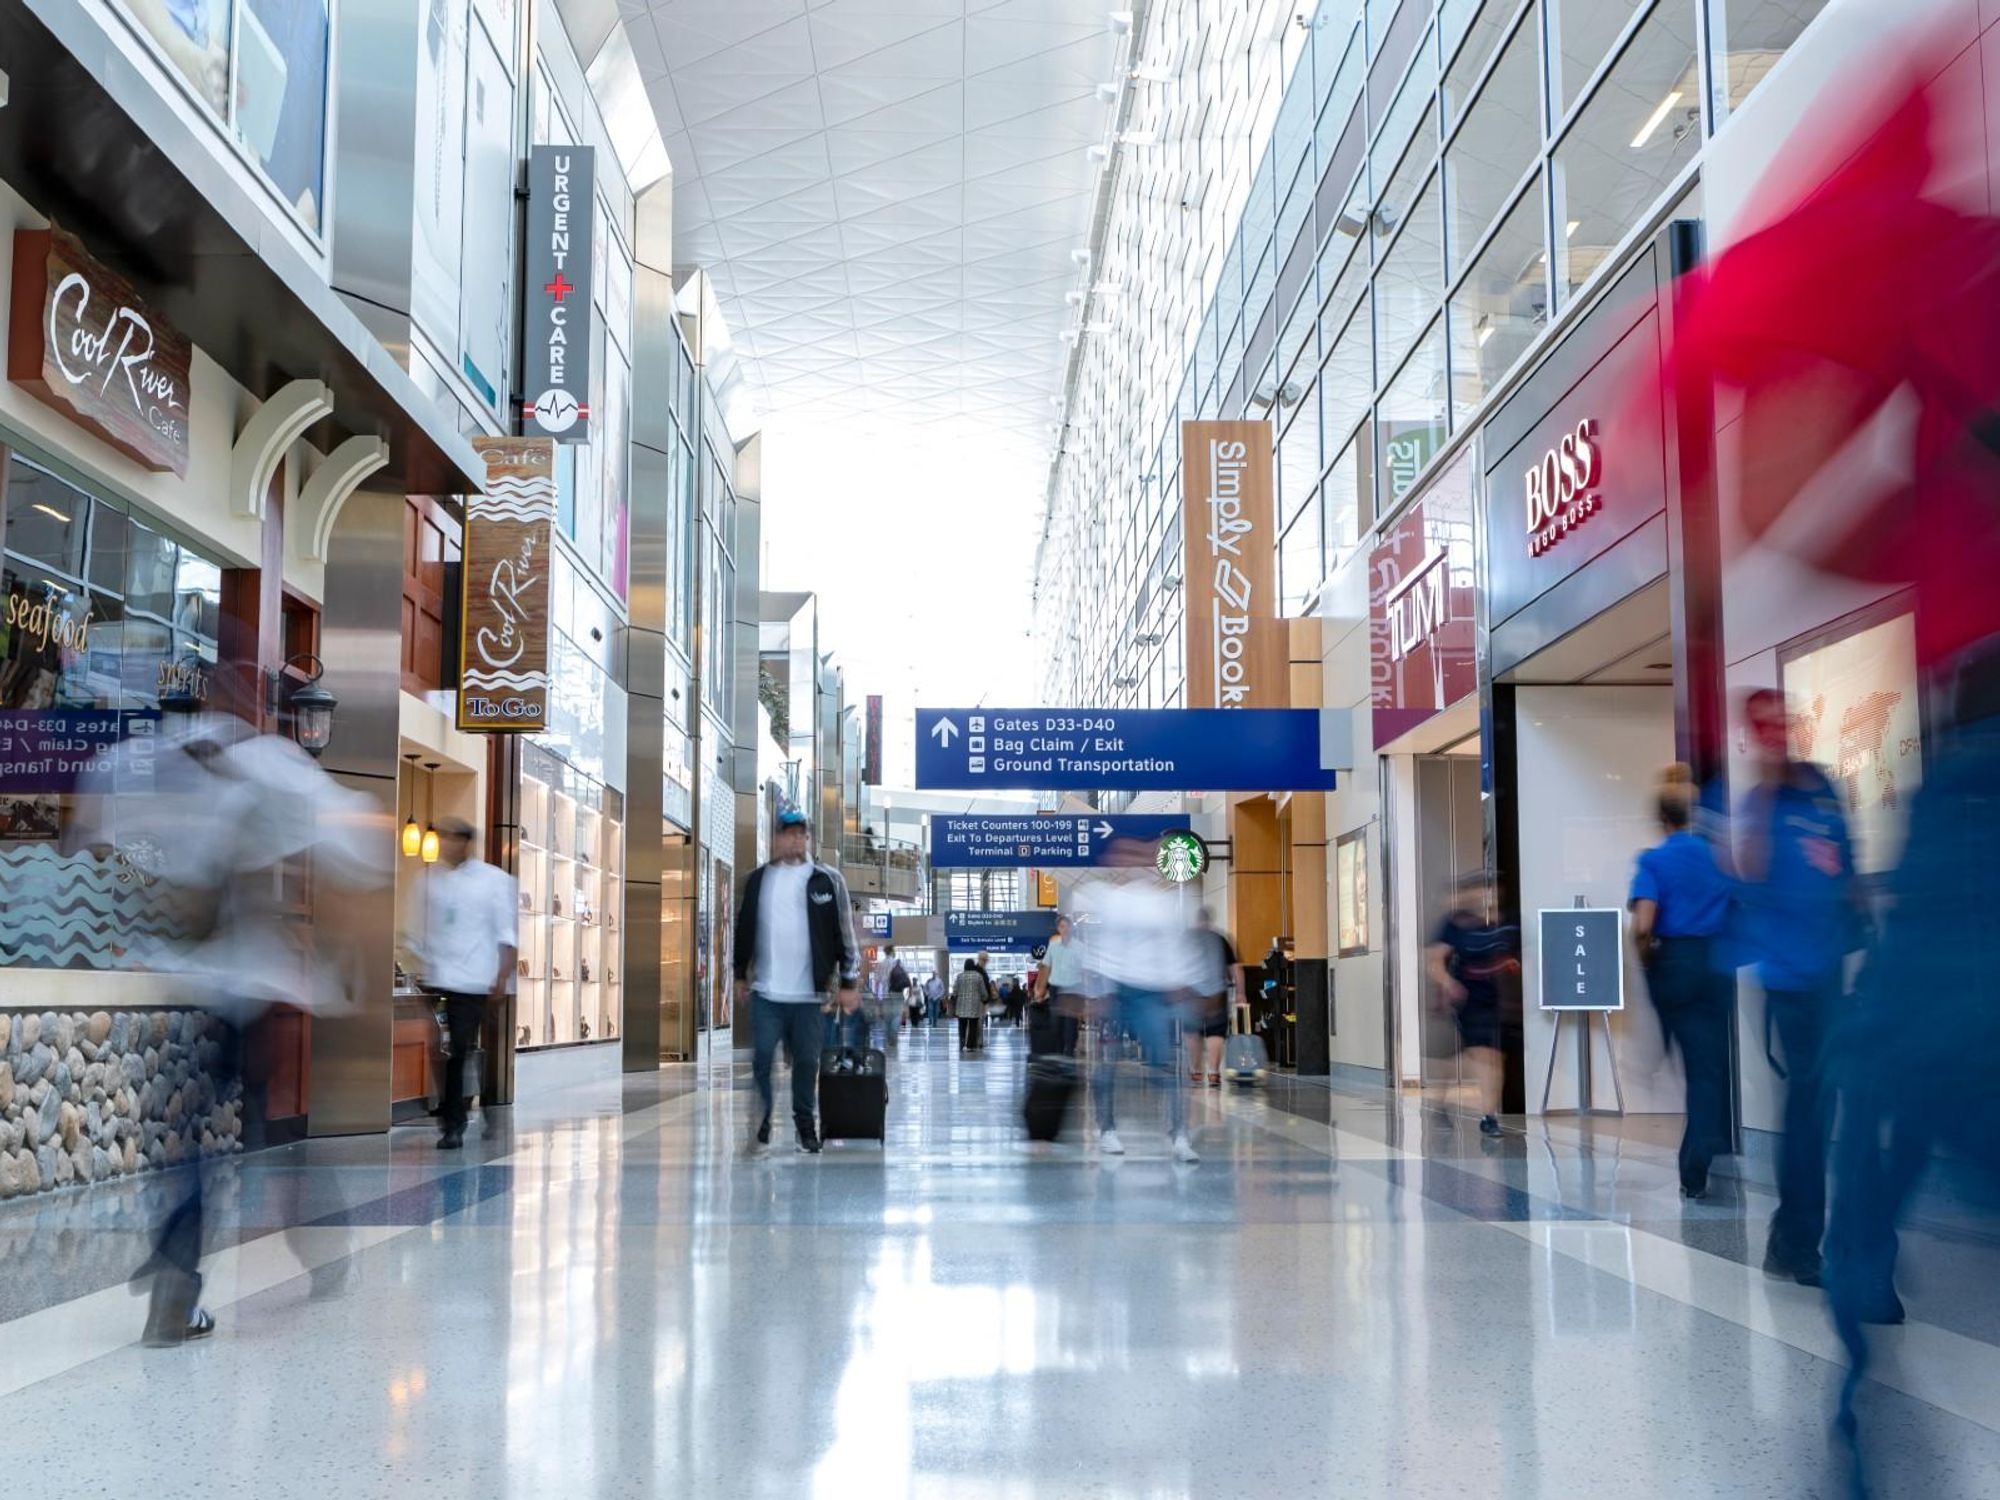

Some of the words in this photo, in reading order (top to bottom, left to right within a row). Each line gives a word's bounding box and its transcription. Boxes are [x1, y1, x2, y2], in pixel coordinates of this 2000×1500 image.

[552, 155, 570, 270] URGENT
[51, 273, 111, 384] Cool
[100, 306, 183, 416] River
[549, 307, 567, 384] CARE
[1206, 440, 1252, 556] Simply
[1525, 418, 1594, 534] BOSS
[1528, 524, 1557, 558] HUGO
[1563, 494, 1593, 532] BOSS
[490, 535, 540, 621] River
[6, 592, 93, 653] seafood
[477, 600, 524, 668] Cool
[1220, 615, 1250, 709] Book
[466, 697, 499, 717] To
[501, 697, 541, 717] Go
[994, 718, 1039, 731] Gates
[1046, 718, 1115, 731] D33-D40
[994, 738, 1024, 754] Bag
[1030, 738, 1074, 752] Claim
[1080, 738, 1089, 753] /
[1095, 738, 1124, 752] Exit
[994, 758, 1052, 772] Ground
[1058, 758, 1174, 775] Transportation
[947, 820, 978, 830] Ticket
[981, 820, 1028, 830] Counters
[1031, 820, 1073, 830] 100-199
[947, 833, 967, 843] Exit
[970, 833, 982, 843] To
[985, 833, 1042, 845] Departures
[1046, 833, 1073, 843] Level
[968, 846, 1013, 857] Terminal
[1033, 846, 1073, 858] Parking
[1575, 925, 1586, 994] SALE
